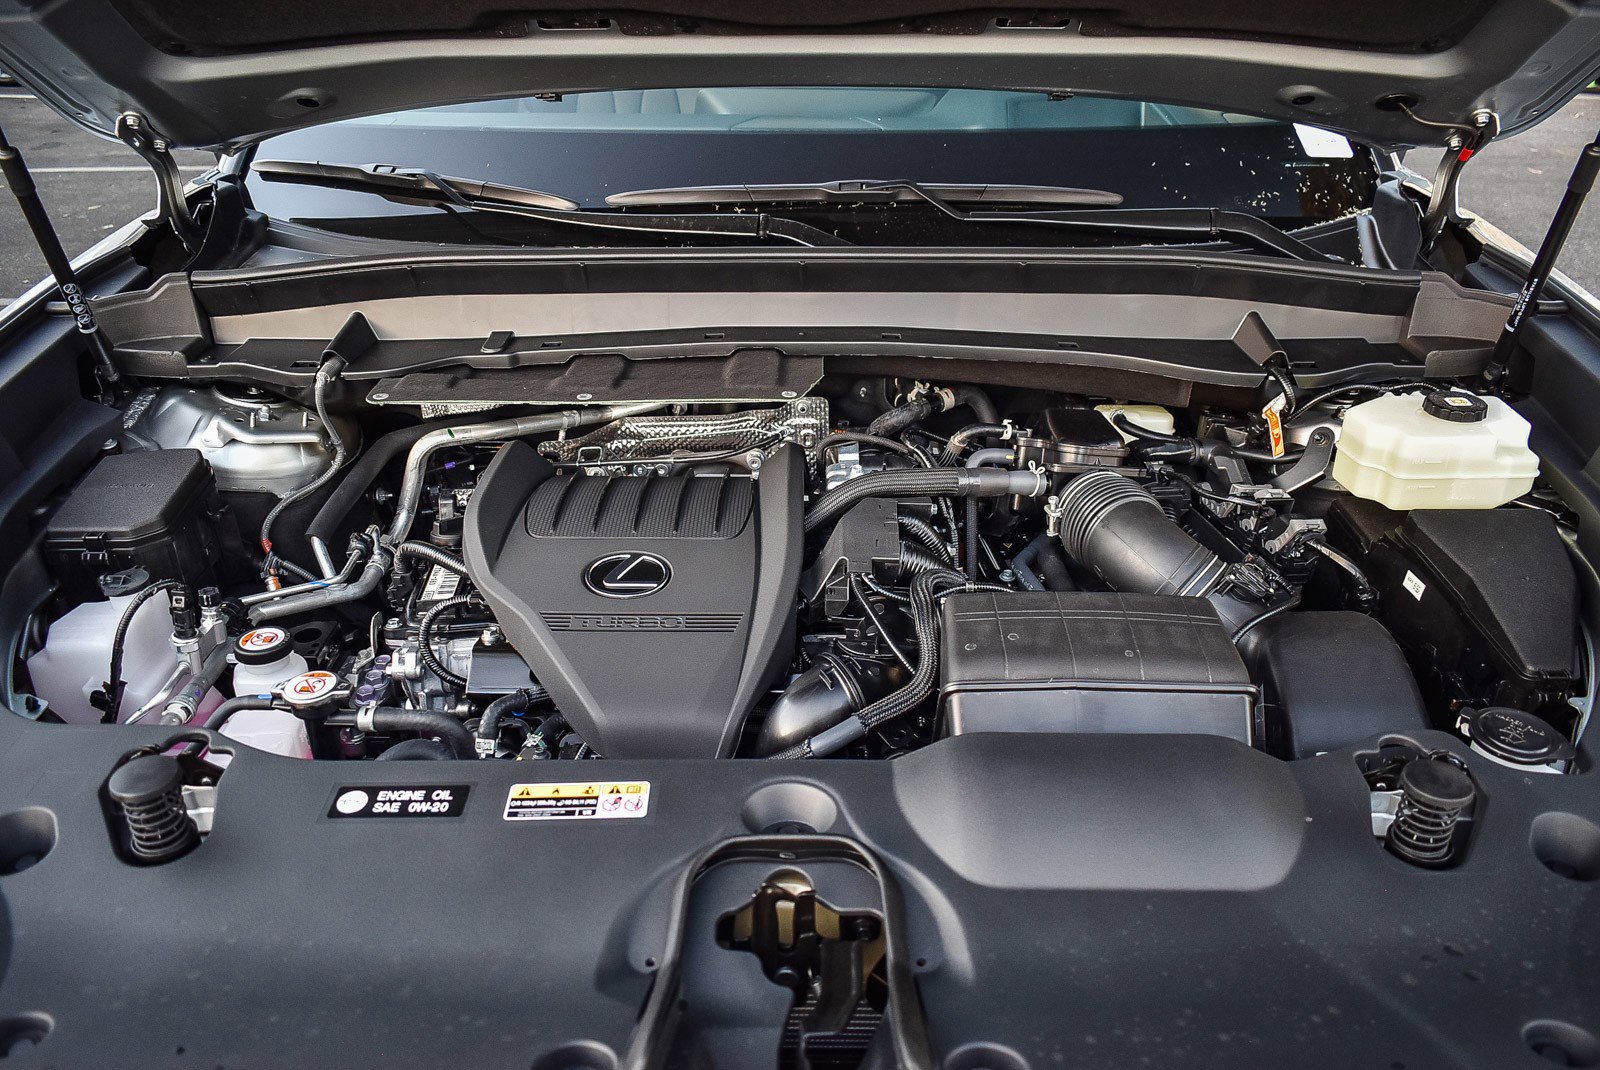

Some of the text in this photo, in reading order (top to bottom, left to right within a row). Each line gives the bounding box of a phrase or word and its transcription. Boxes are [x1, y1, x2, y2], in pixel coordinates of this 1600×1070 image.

[574, 616, 684, 629] TURBO
[377, 789, 453, 801] ENGINE OIL
[372, 802, 449, 813] SAE 0W-20
